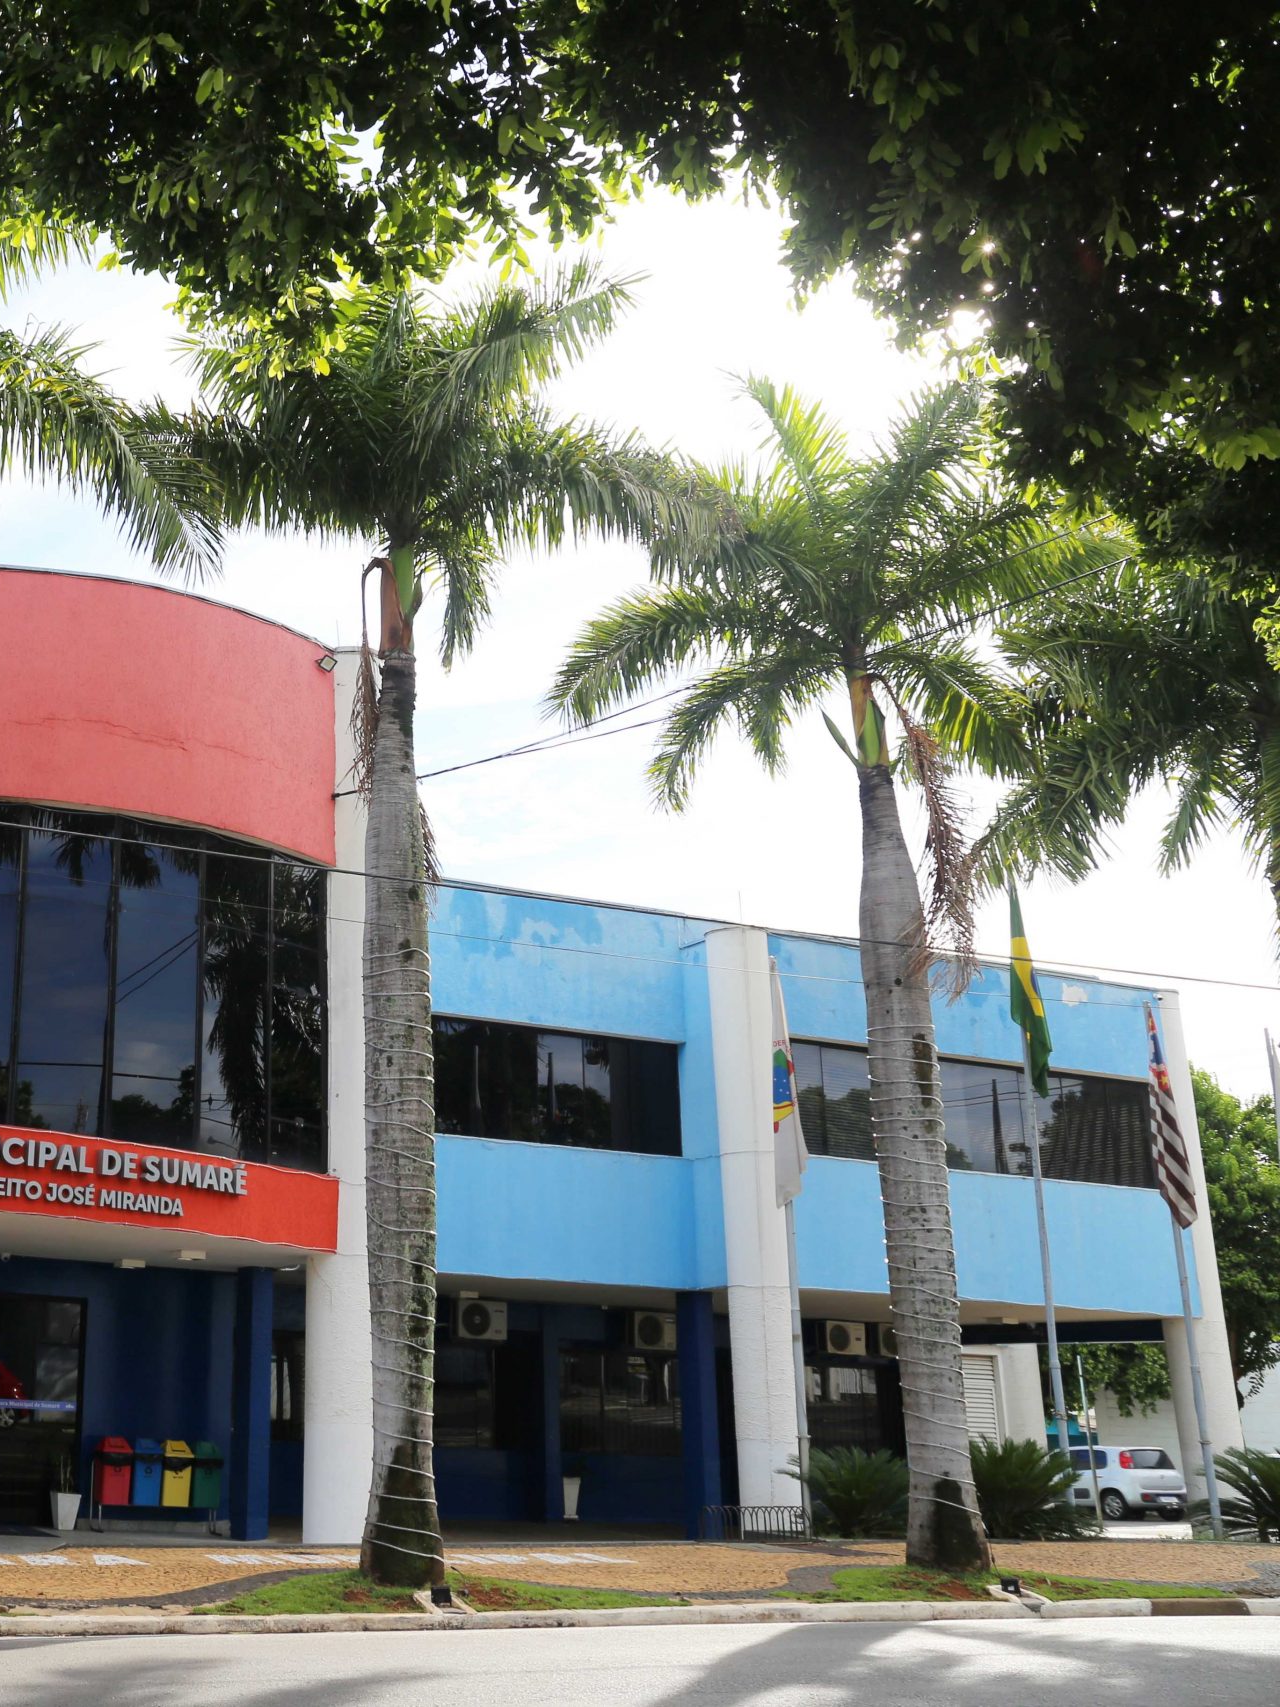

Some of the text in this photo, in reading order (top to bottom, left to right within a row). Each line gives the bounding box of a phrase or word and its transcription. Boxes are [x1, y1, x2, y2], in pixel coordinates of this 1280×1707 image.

[101, 1149, 139, 1180] DE
[143, 1156, 248, 1196] SUMARÉ
[46, 1183, 96, 1207] JOSÉ
[99, 1189, 184, 1217] MIRANDA
